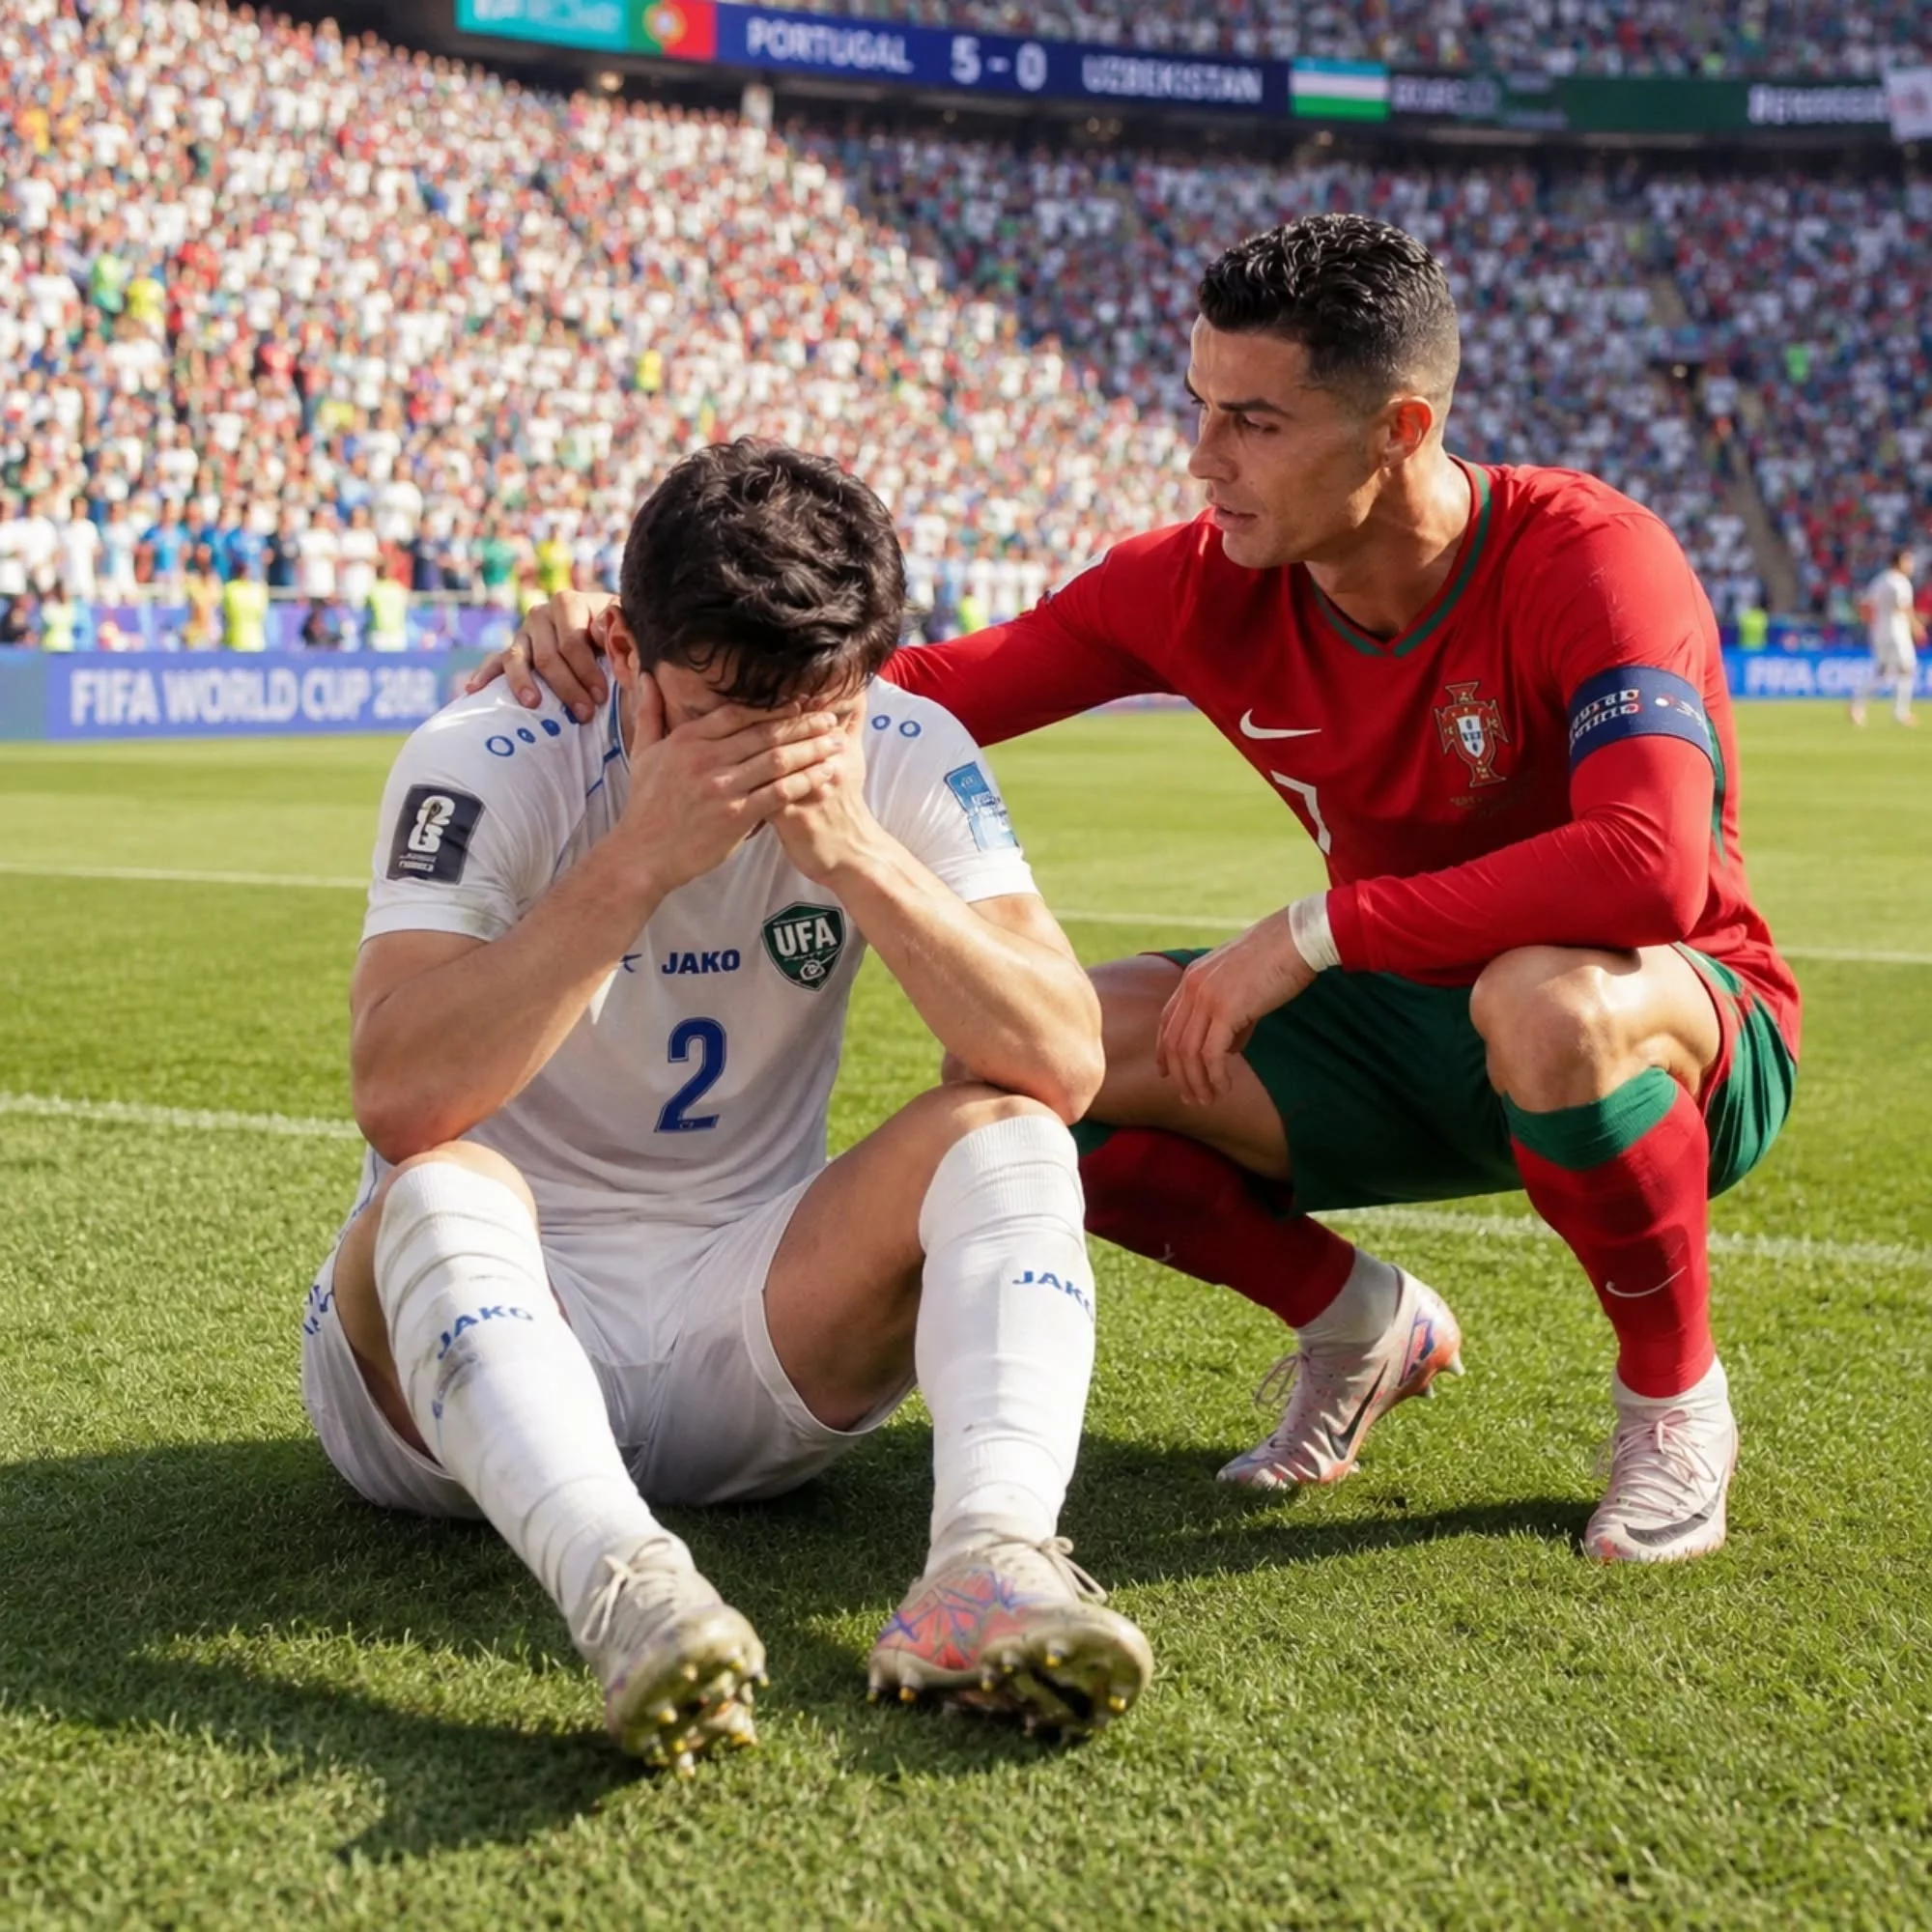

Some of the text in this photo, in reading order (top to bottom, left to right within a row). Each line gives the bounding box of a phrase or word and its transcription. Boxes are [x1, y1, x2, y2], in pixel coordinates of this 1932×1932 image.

[746, 16, 915, 74] PORTUGAL
[1081, 53, 1264, 103] UZBEKISTAN
[70, 668, 160, 725] FIFA
[162, 667, 299, 724] WORLD
[301, 667, 372, 722] CUP
[1269, 769, 1331, 856] 7
[662, 949, 741, 975] JAKO
[773, 917, 838, 956] UFA
[654, 1016, 727, 1133] 2
